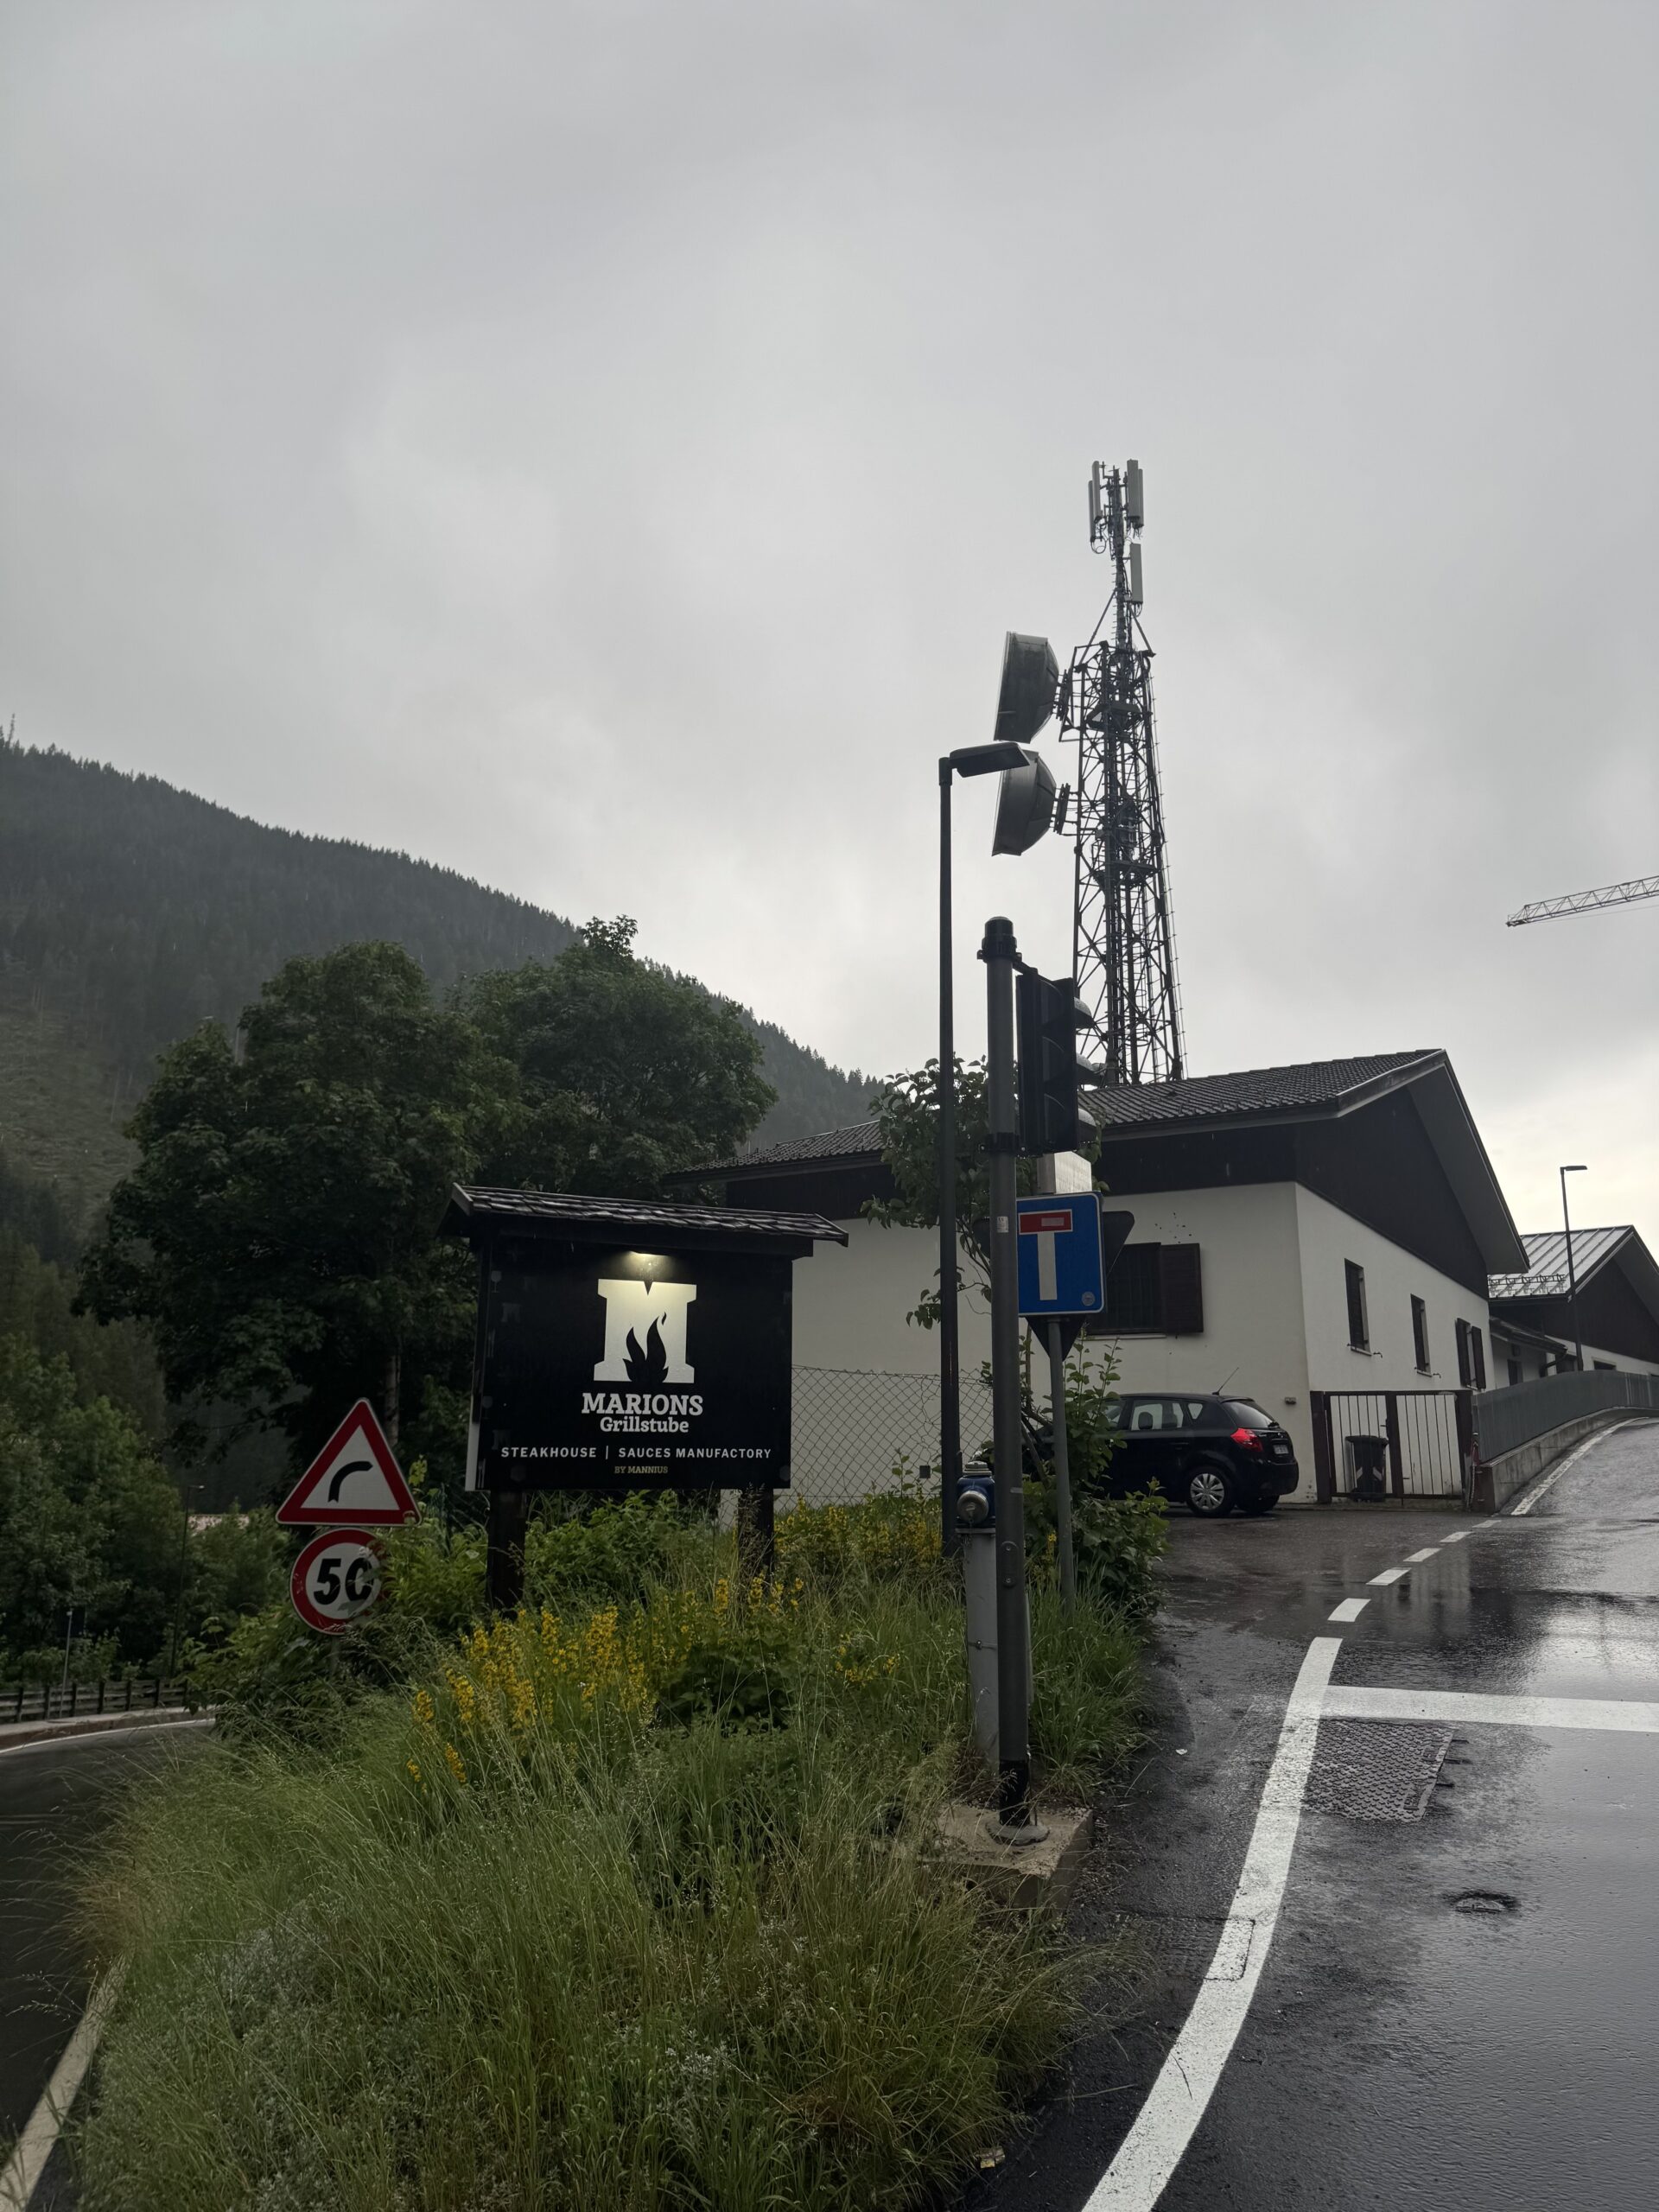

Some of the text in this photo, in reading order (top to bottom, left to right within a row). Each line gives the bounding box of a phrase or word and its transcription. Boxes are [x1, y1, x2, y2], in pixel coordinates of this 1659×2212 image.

[581, 1392, 704, 1416] MARIONS
[600, 1415, 690, 1433] Grillstube
[500, 1446, 772, 1459] STEAKHOUSE SAUCES MANUFACTORY
[614, 1465, 627, 1474] BY
[313, 1557, 375, 1605] 50
